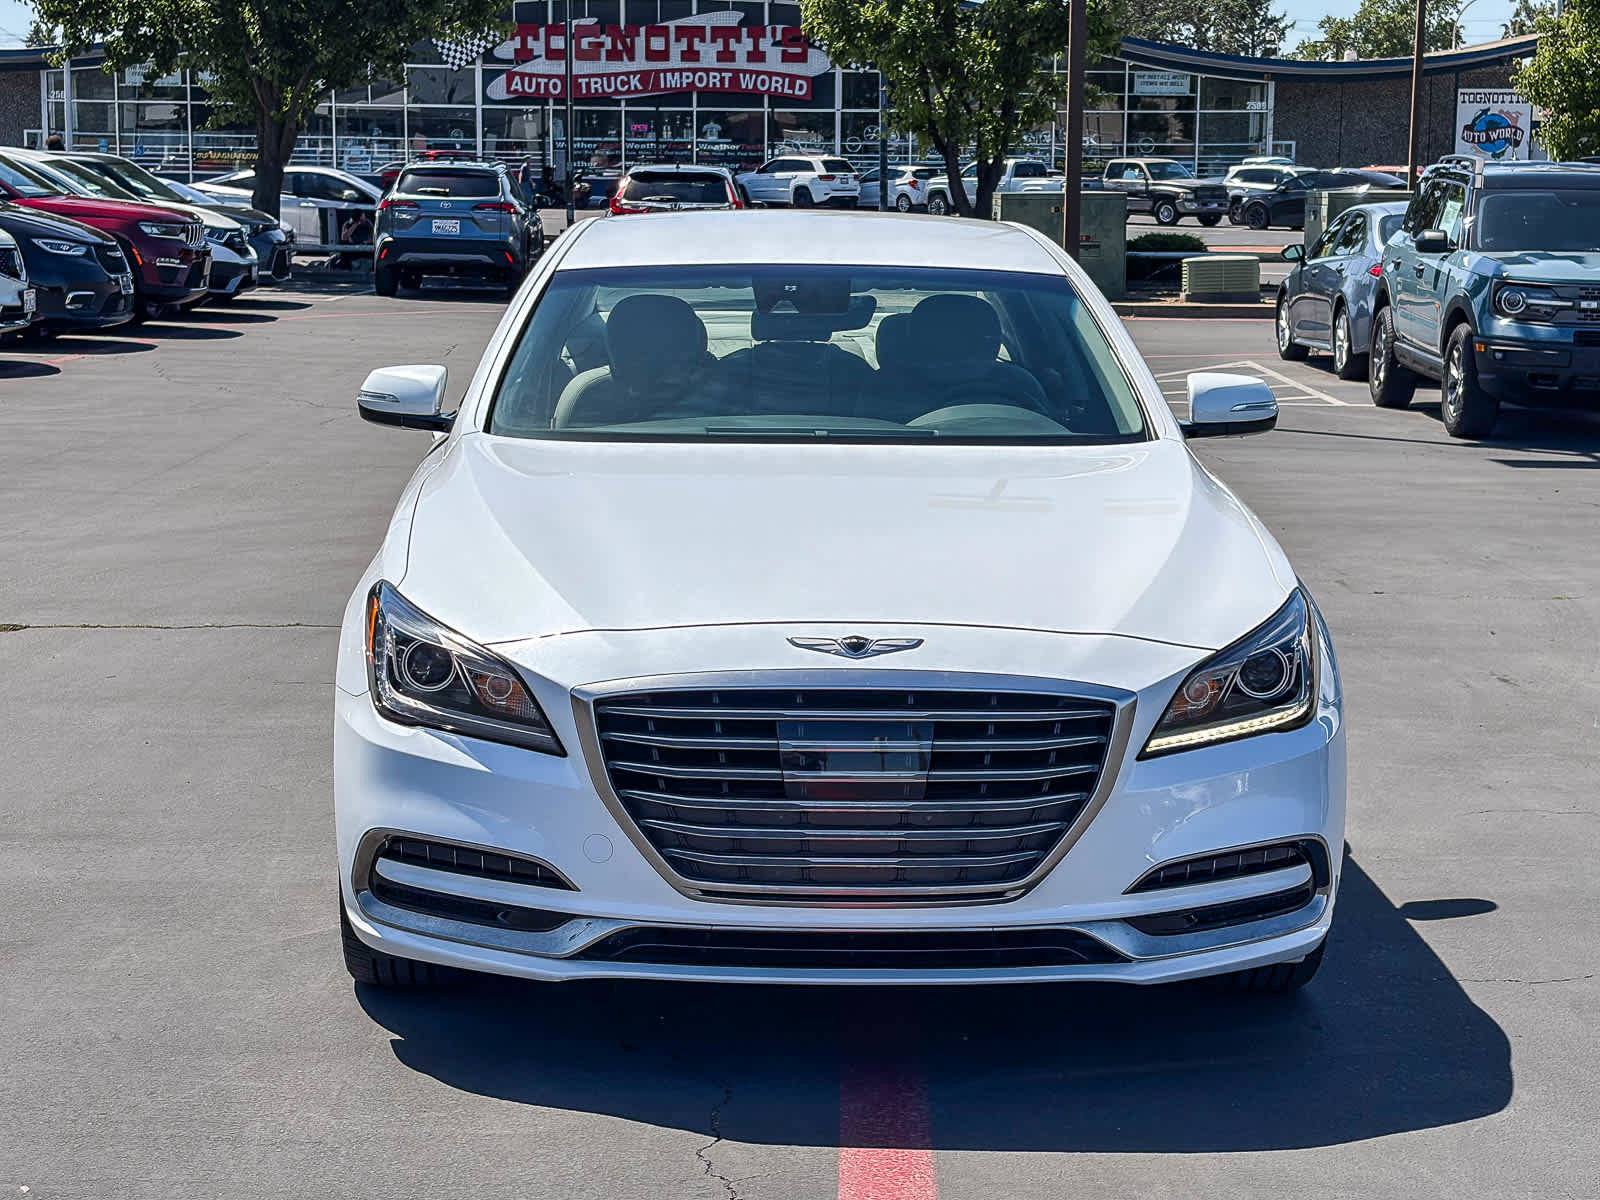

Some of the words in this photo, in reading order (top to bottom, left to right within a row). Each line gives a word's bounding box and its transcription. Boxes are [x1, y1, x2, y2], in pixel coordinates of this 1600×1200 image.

[511, 23, 809, 63] TOGNOTTI'S
[510, 74, 562, 95] AUTO
[578, 73, 643, 95] TRUCK
[660, 71, 733, 89] IMPORT
[739, 73, 808, 96] WORLD
[1460, 92, 1529, 104] TOGNOTTI
[1462, 130, 1486, 143] AUTO
[1488, 127, 1523, 141] WORLD
